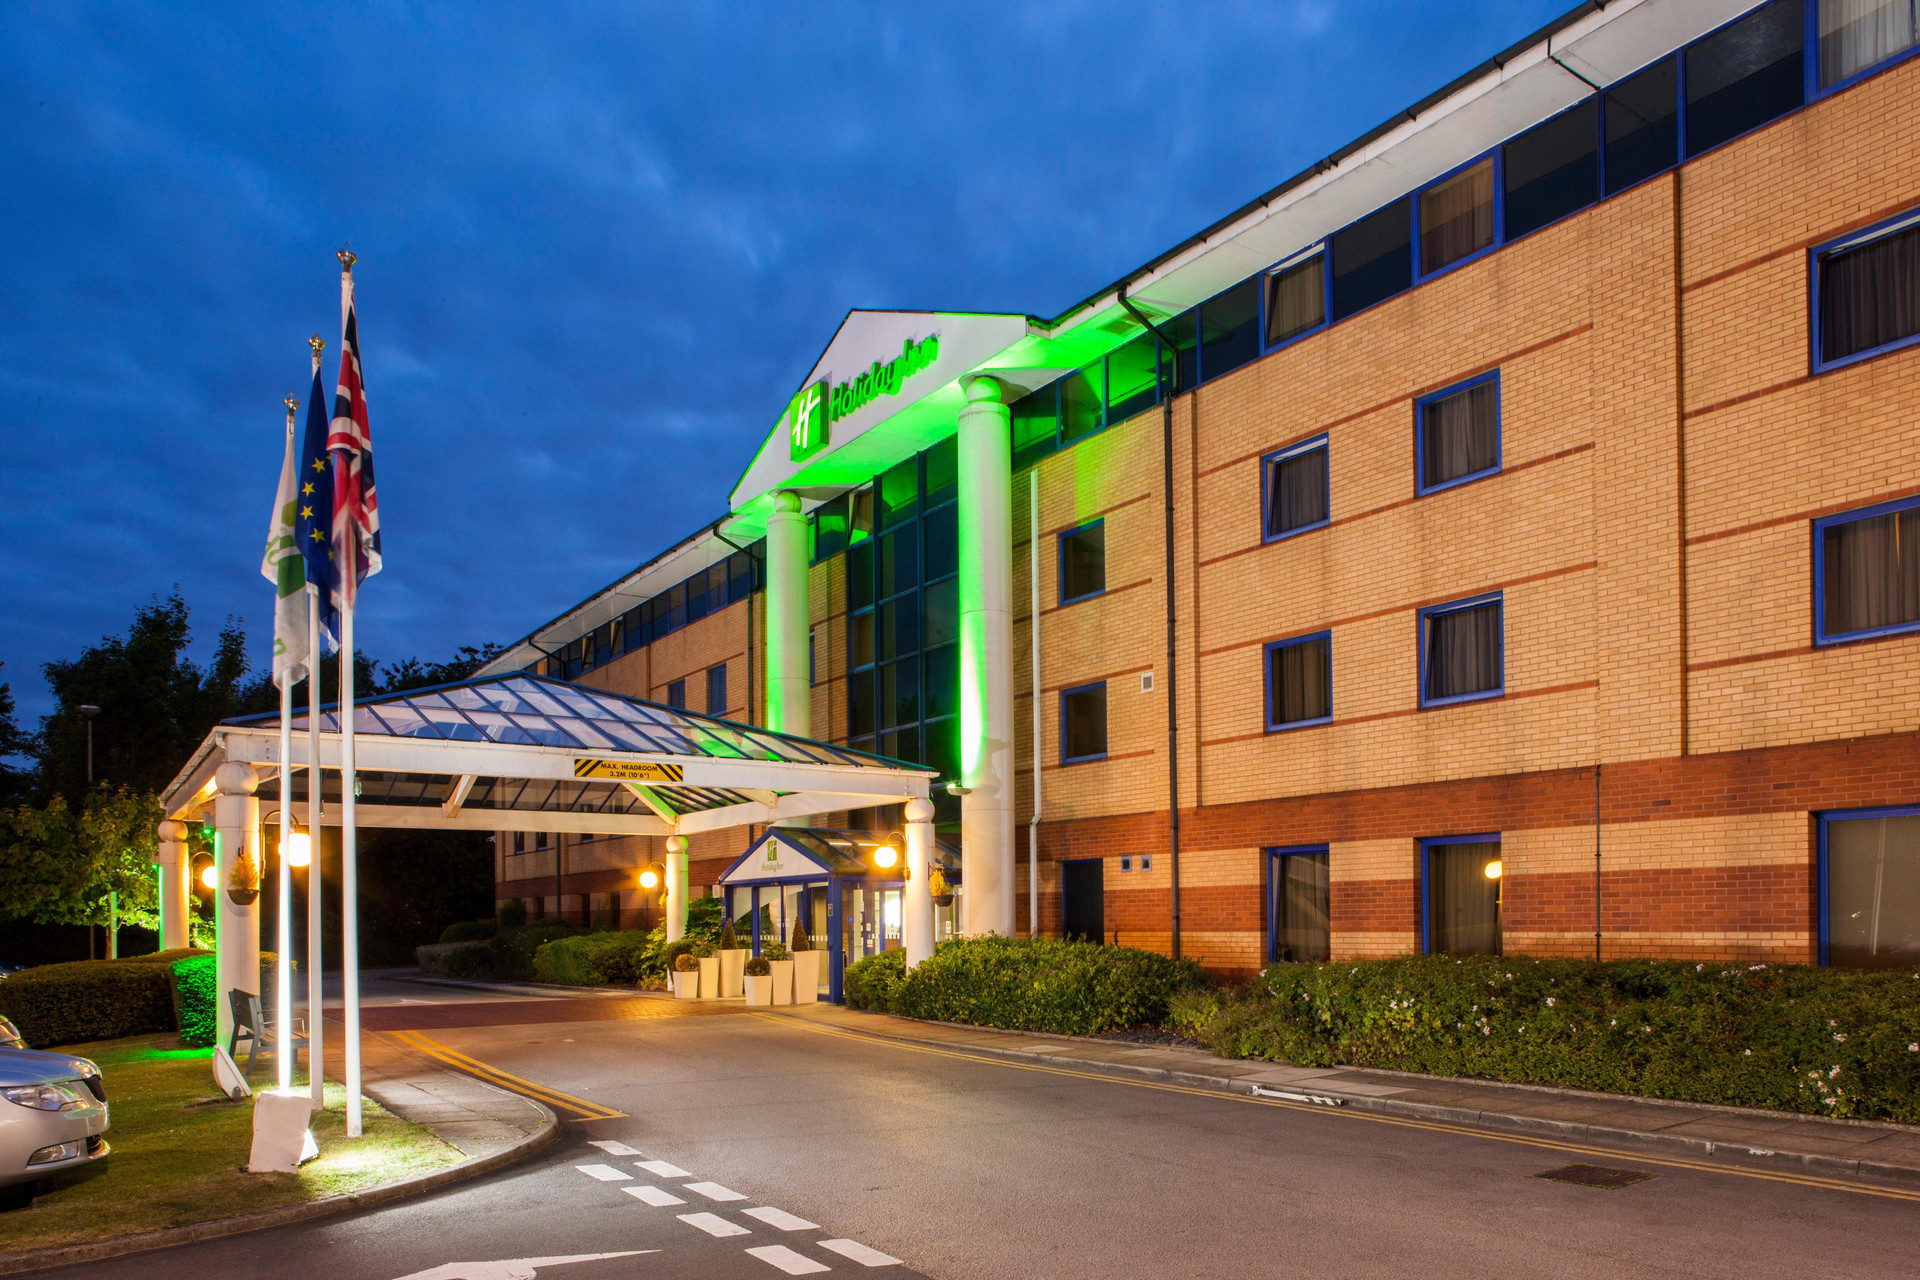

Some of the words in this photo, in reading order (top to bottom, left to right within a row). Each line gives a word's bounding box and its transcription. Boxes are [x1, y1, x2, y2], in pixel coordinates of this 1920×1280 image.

[829, 356, 903, 423] Holiday
[902, 336, 939, 378] Inn
[621, 764, 658, 772] HEADROOM
[761, 862, 777, 872] Holiday
[776, 862, 784, 870] Inn
